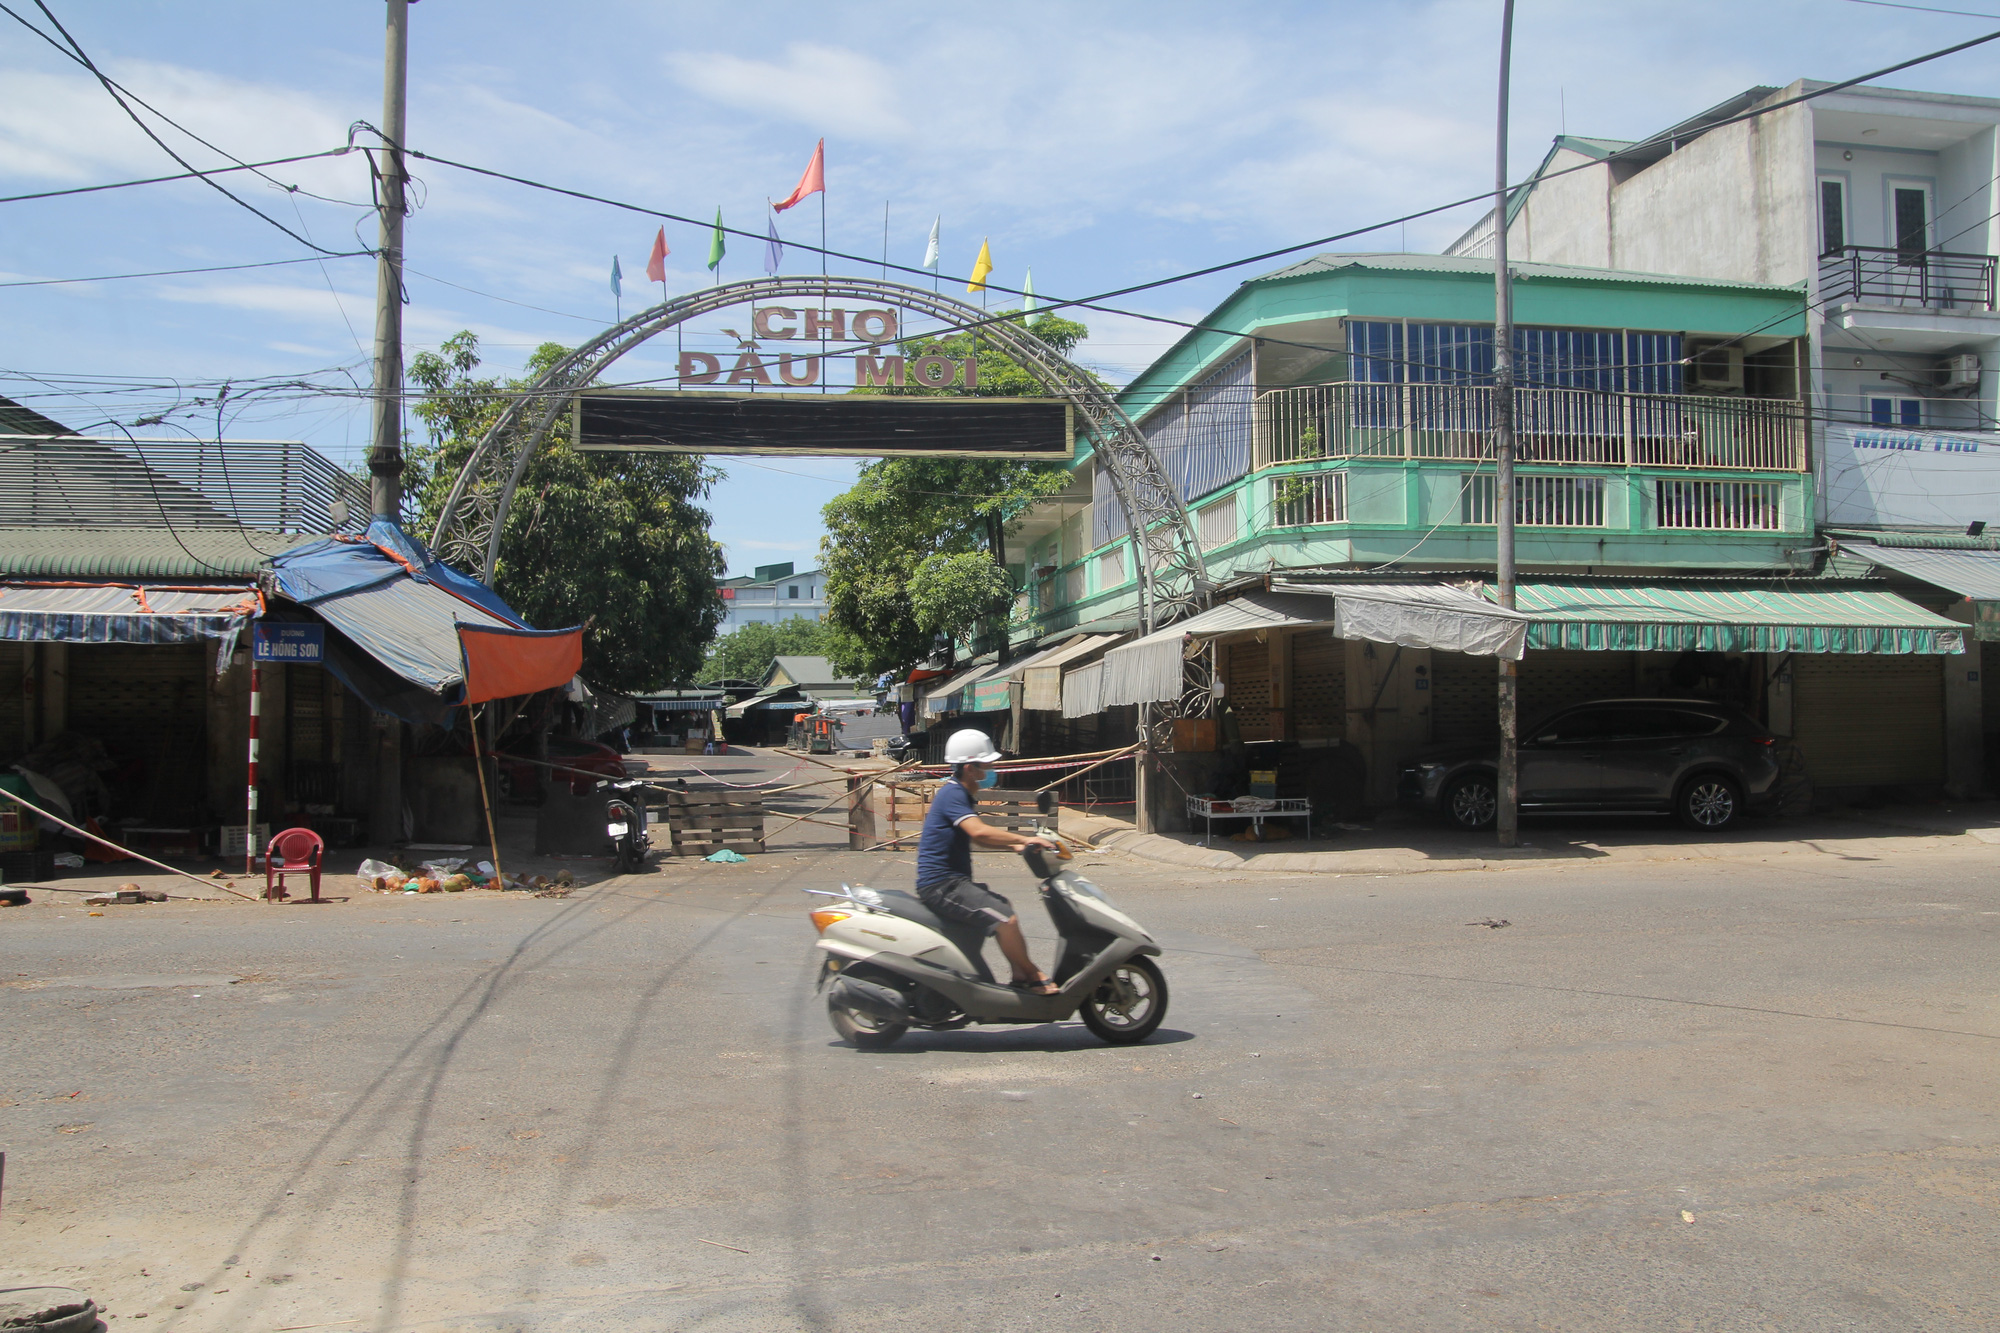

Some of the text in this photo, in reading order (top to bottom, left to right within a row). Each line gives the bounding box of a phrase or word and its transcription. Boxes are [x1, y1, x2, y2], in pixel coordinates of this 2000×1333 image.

[674, 328, 978, 389] ĐẦU MỐI
[1853, 432, 1922, 451] Minh
[258, 640, 270, 656] LÊ
[299, 642, 319, 658] SƠN
